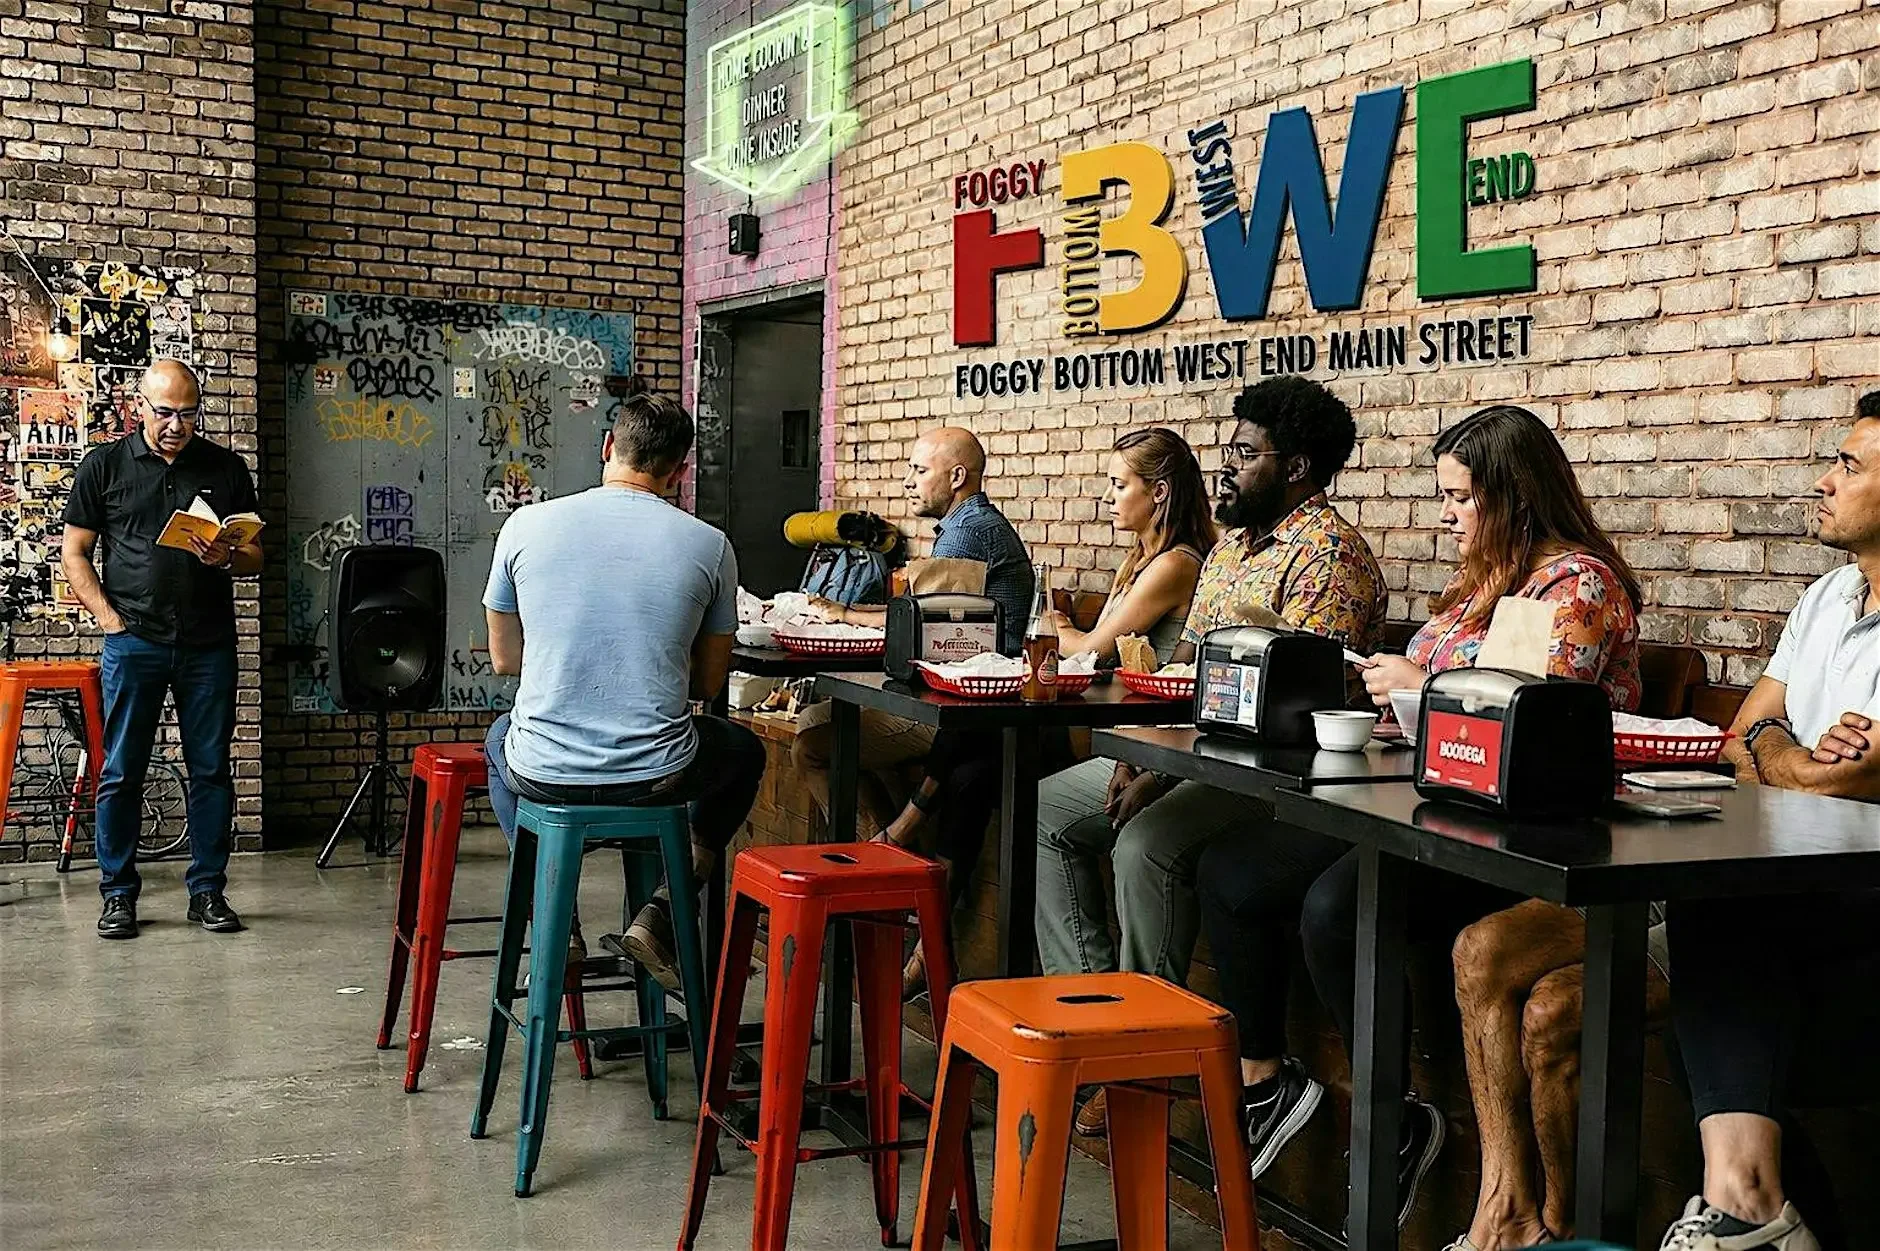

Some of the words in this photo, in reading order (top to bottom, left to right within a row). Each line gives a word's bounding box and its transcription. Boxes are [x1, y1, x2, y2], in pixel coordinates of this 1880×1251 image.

[743, 84, 786, 126] DINNER
[758, 120, 801, 161] INSIDE
[955, 158, 1047, 209] FOGGY
[1187, 119, 1239, 220] WEST
[1467, 152, 1536, 207] END
[1062, 206, 1100, 338] BOTTOM
[956, 358, 1045, 398] FOGGY
[1055, 348, 1164, 390] BOTTOM
[1174, 340, 1249, 382] WEST
[1259, 335, 1317, 375] END
[1328, 326, 1407, 371] MAIN
[1419, 315, 1534, 365] STREET
